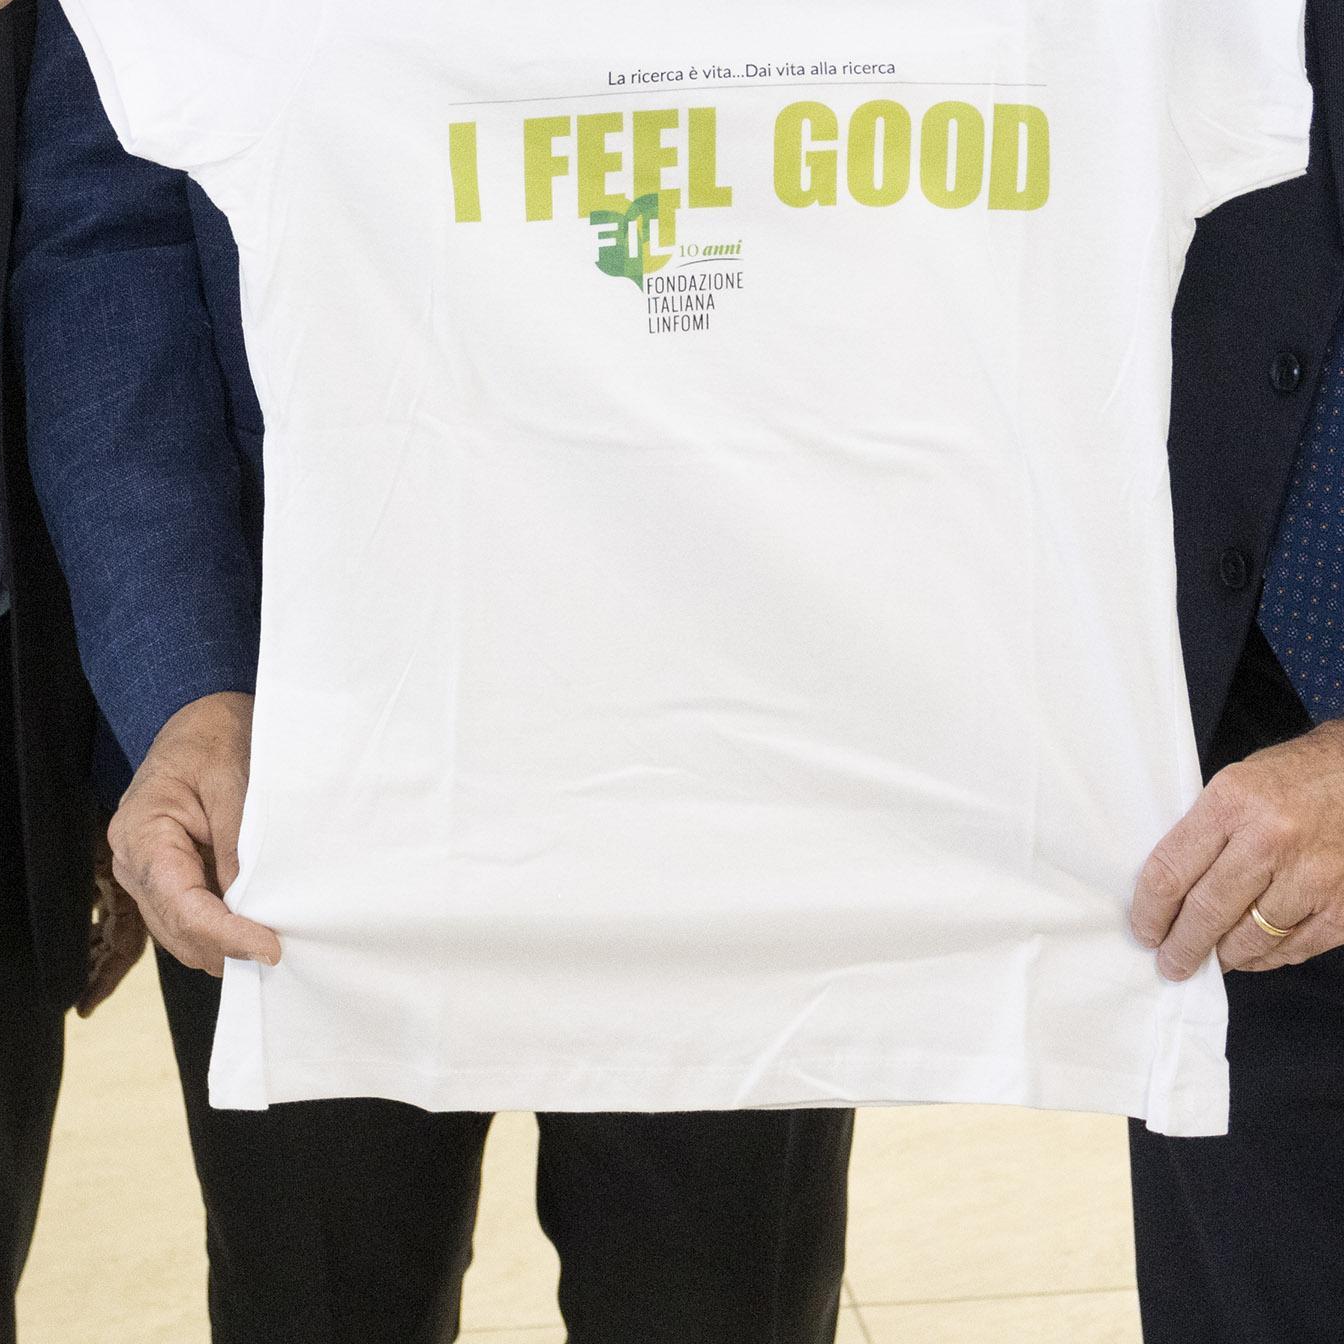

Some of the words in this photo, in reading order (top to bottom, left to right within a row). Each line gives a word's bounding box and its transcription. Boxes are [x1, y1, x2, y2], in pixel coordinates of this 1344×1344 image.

[608, 71, 625, 86] La
[631, 68, 684, 84] ricerca
[689, 66, 698, 81] è
[776, 62, 805, 77] vita
[810, 61, 837, 76] alla
[842, 60, 896, 76] ricerca
[448, 121, 482, 223] I
[523, 107, 733, 222] FEEL
[773, 99, 1050, 212] GOOD
[679, 243, 699, 258] 10
[702, 239, 742, 257] anni
[647, 271, 744, 295] FONDAZIONE
[647, 293, 715, 314] ITALIANA
[648, 313, 710, 334] LINFOMI
